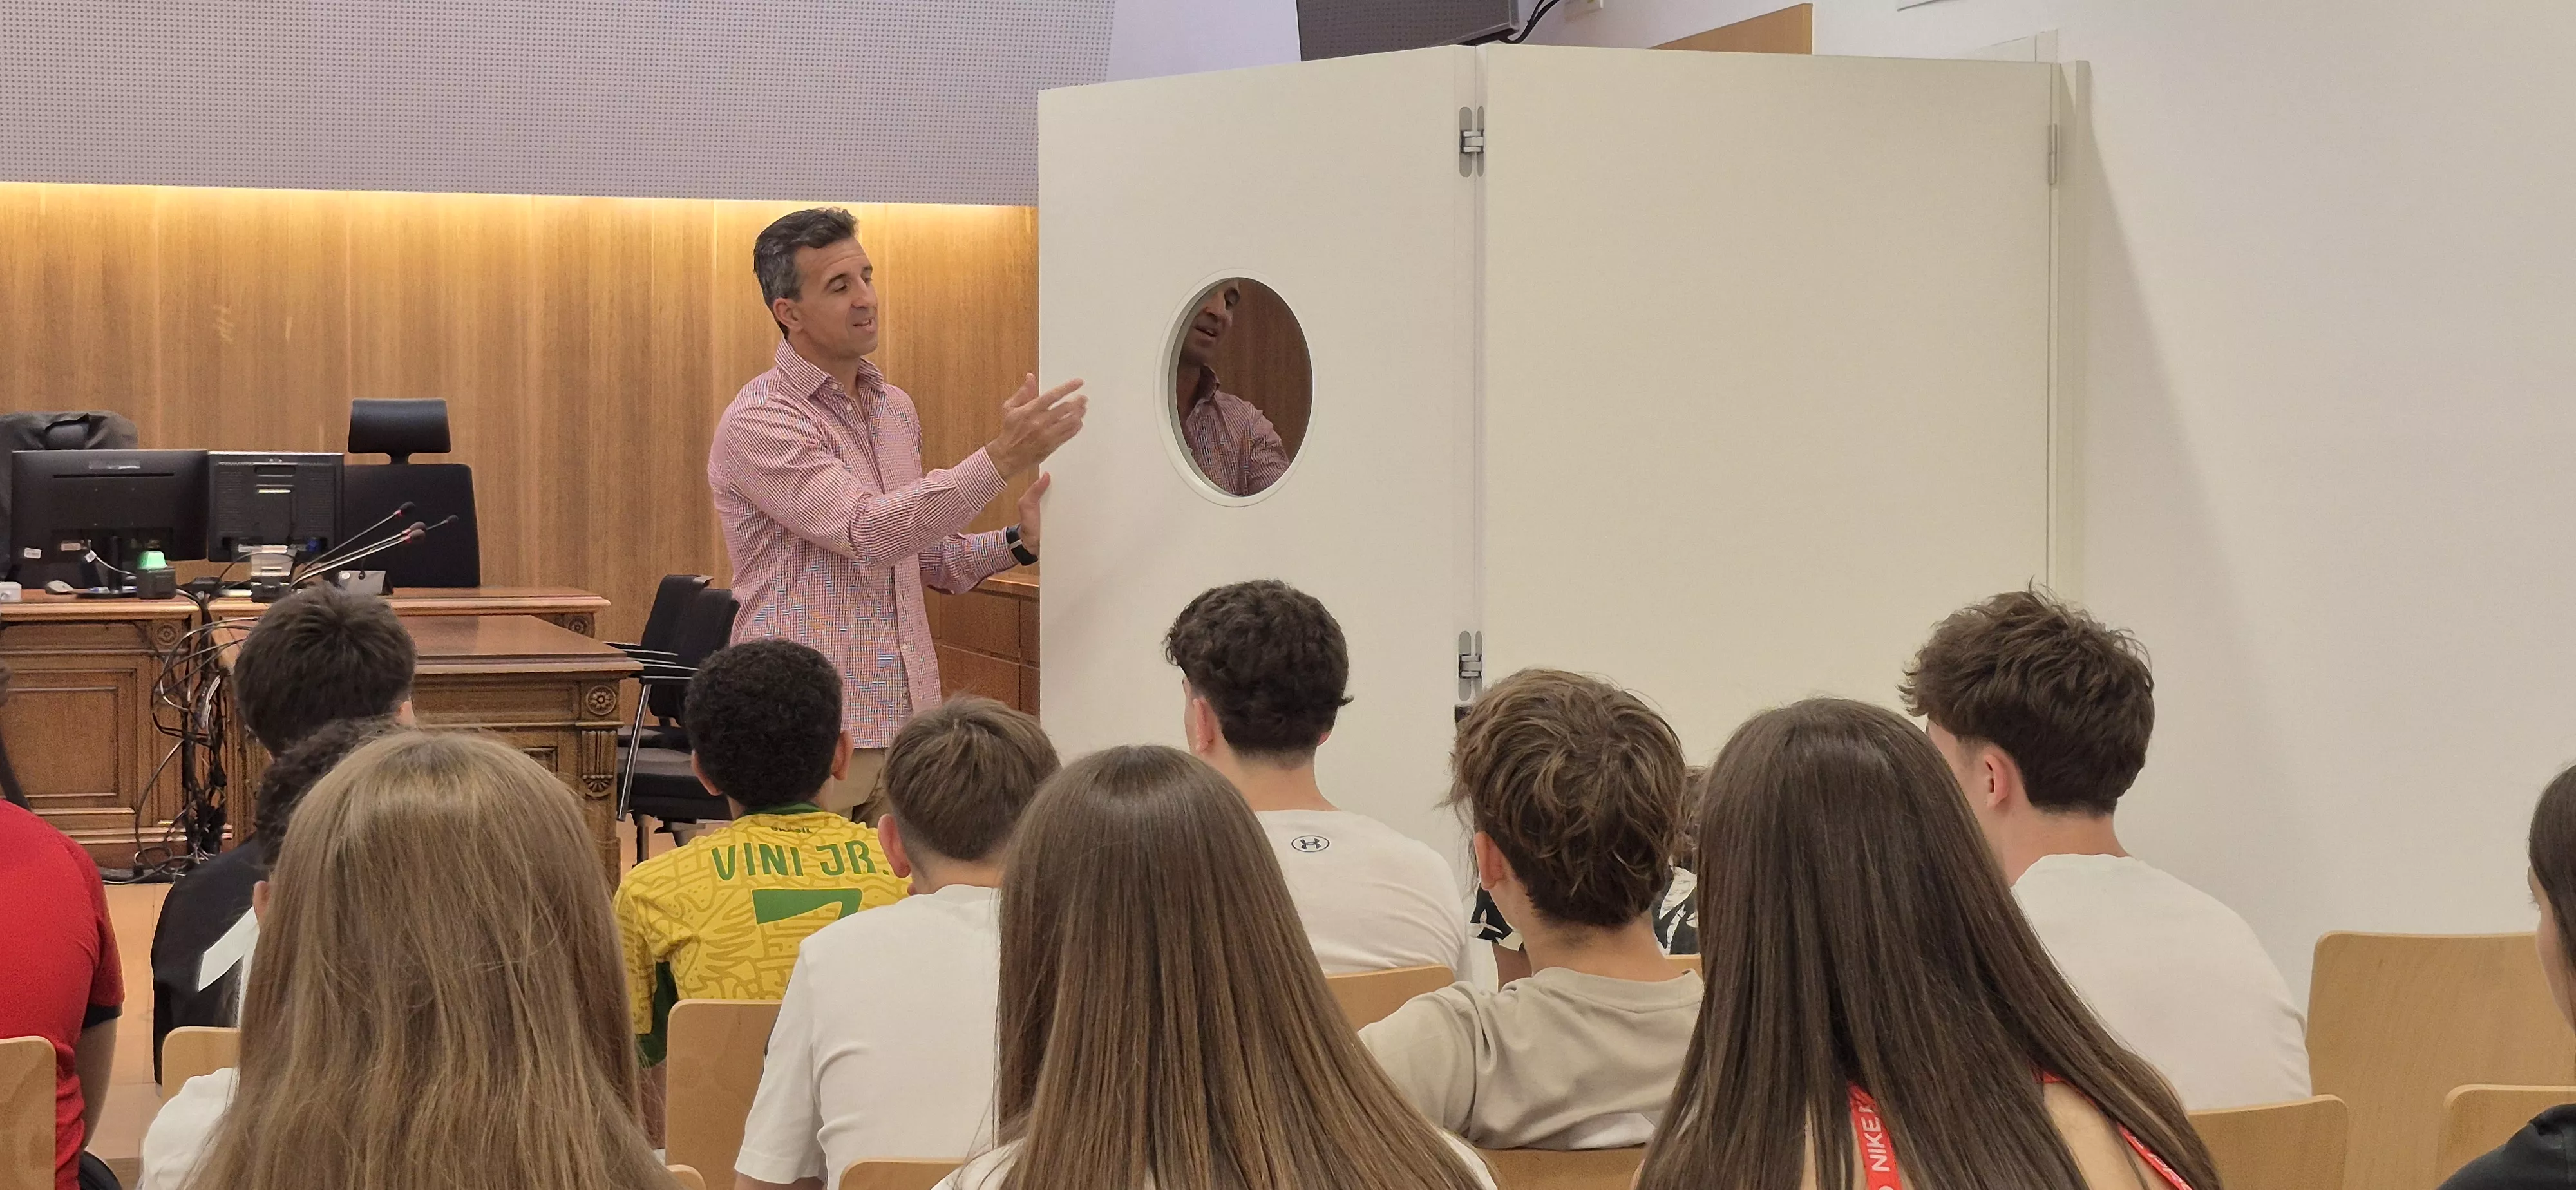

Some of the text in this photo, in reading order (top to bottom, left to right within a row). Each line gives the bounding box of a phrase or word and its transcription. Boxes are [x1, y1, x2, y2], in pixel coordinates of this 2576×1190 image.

[712, 840, 890, 881] VINI JR.
[1861, 1117, 1890, 1172] NIKE
